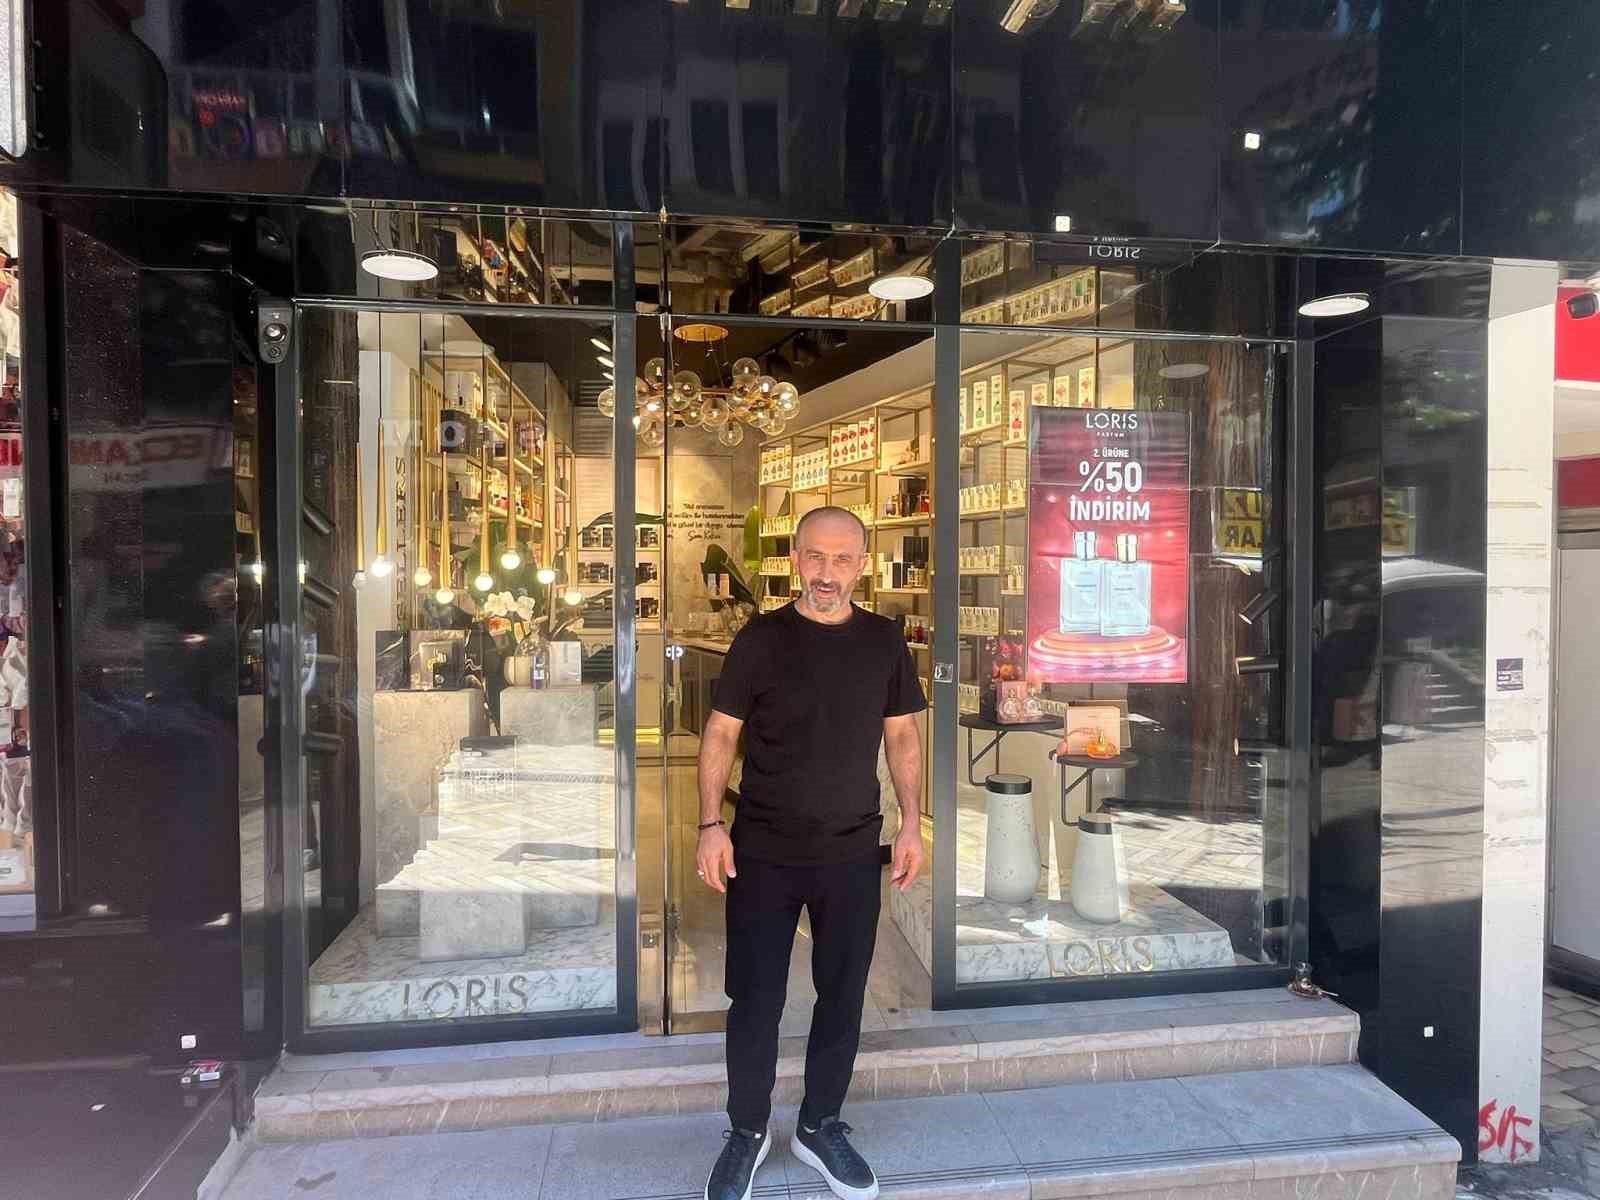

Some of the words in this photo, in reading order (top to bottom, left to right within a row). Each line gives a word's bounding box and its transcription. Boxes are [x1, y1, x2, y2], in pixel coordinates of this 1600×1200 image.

[1086, 412, 1138, 430] LORIS
[1102, 446, 1130, 458] ÜRÜNE
[1079, 460, 1143, 493] %50
[1069, 494, 1150, 521] İNDİRİM
[1045, 936, 1154, 978] LORIS
